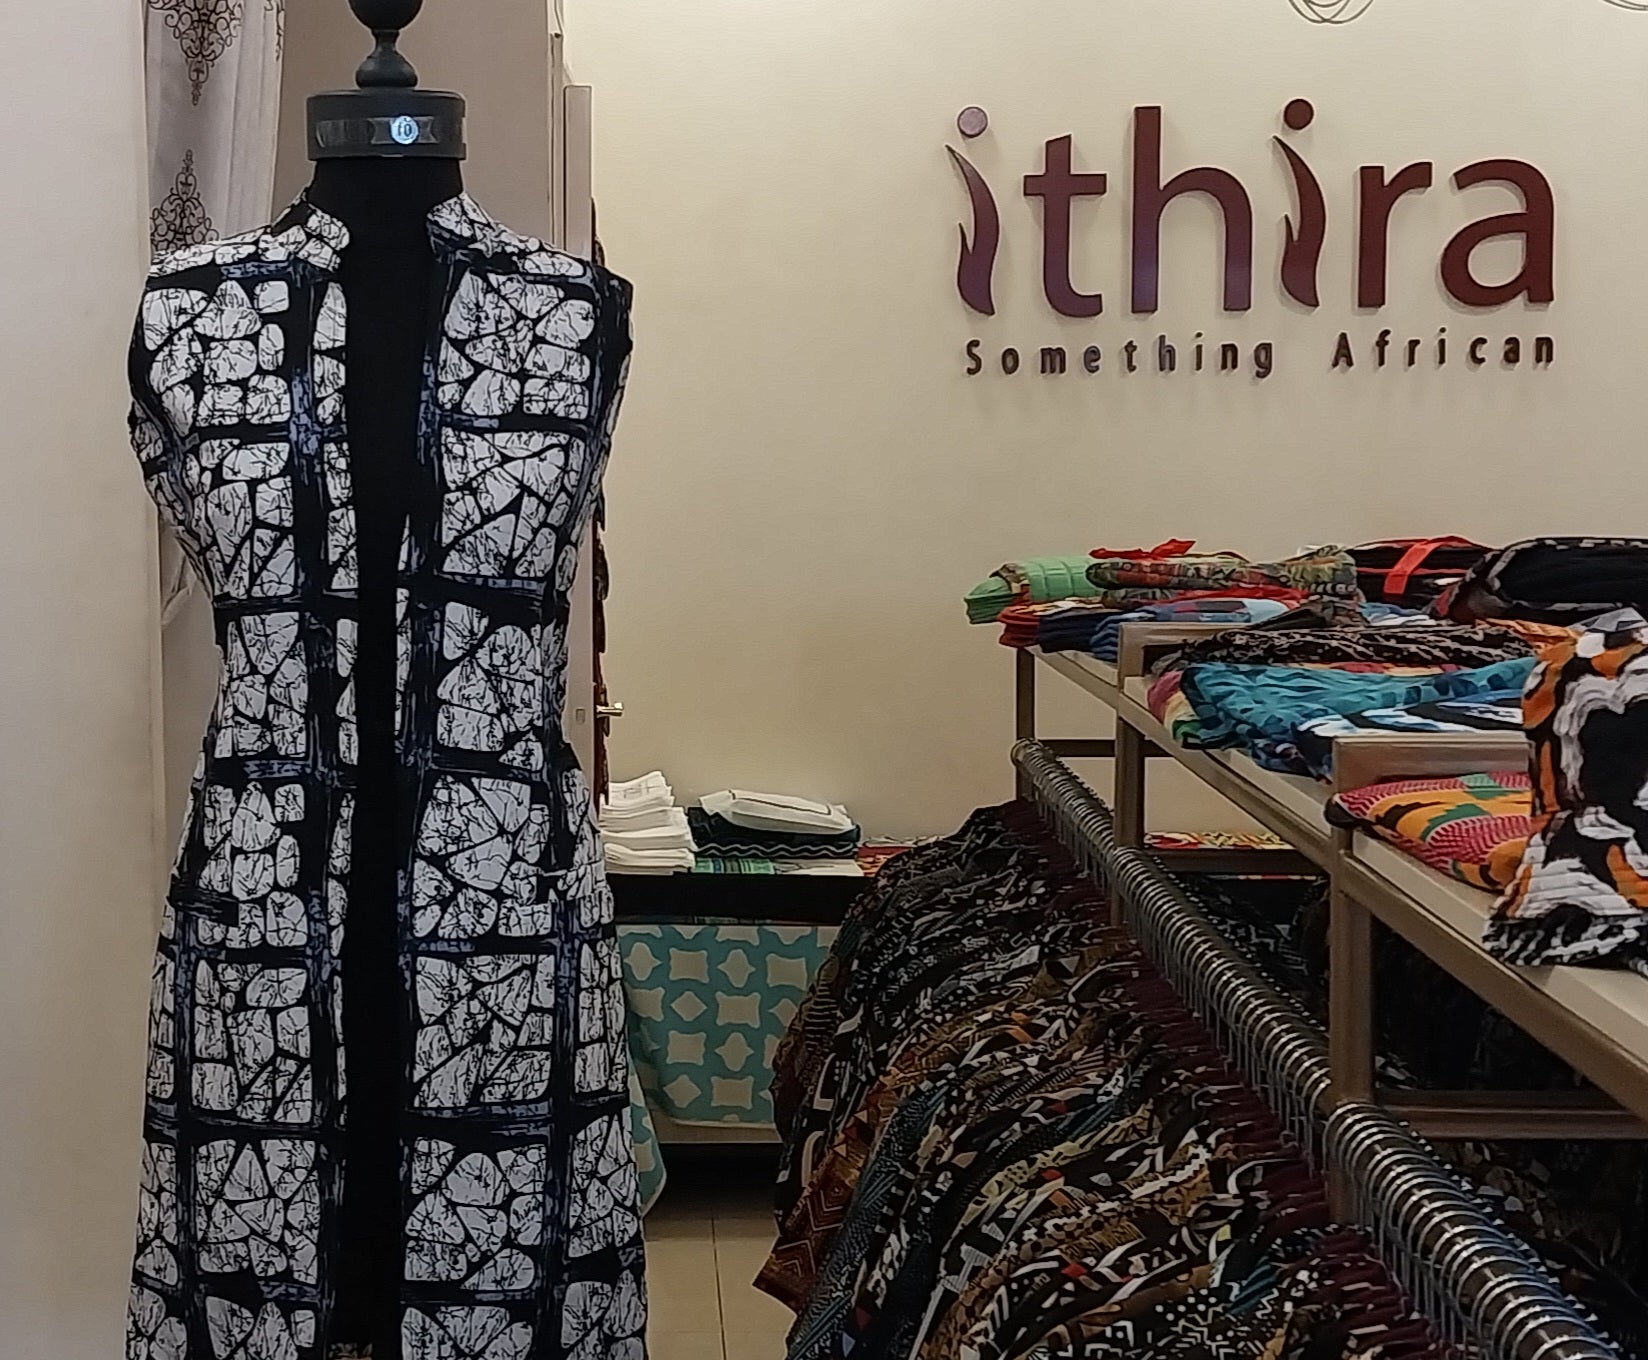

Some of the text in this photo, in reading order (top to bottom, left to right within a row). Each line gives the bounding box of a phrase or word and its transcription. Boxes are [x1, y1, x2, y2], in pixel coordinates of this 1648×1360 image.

[945, 98, 1555, 319] ithira
[966, 326, 1555, 380] Something African
